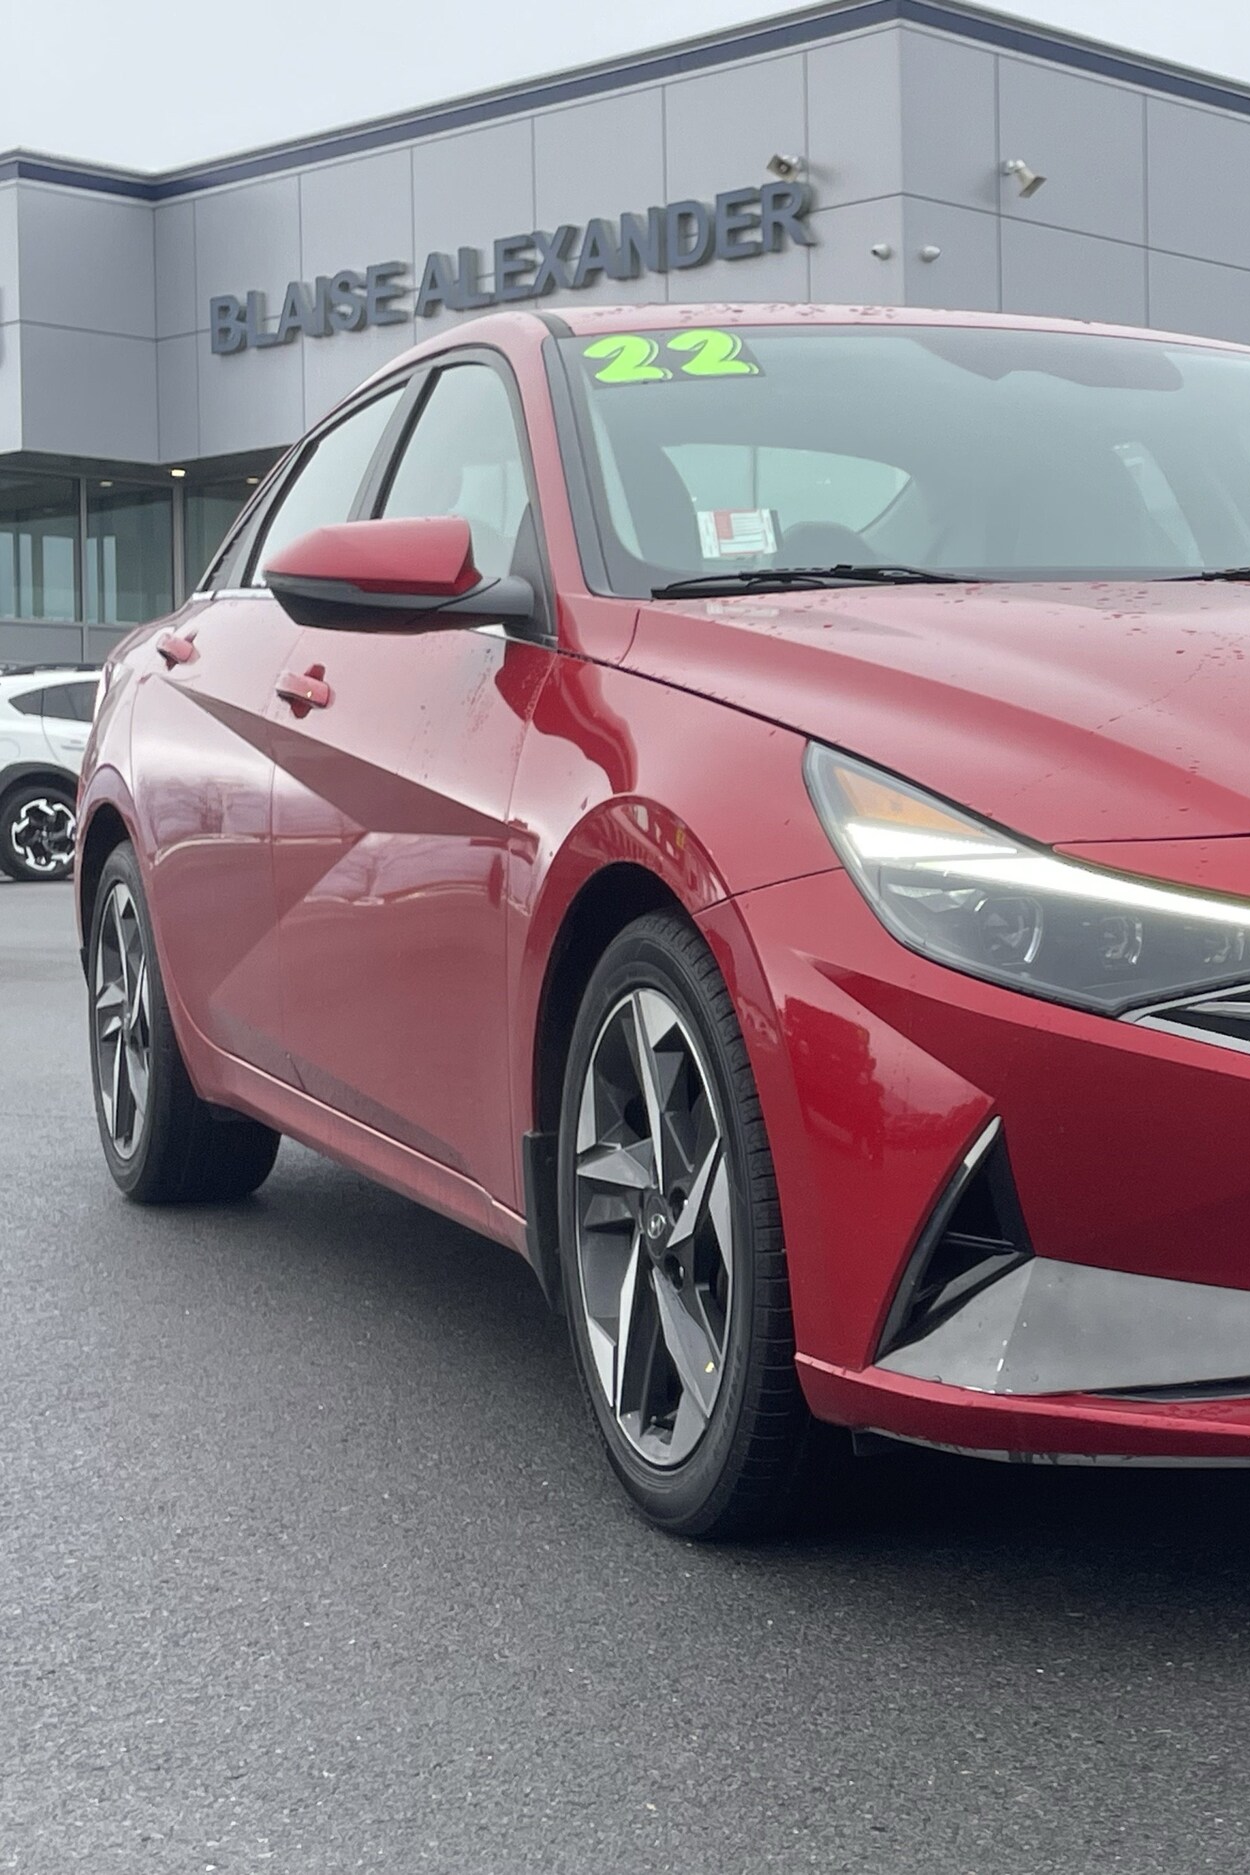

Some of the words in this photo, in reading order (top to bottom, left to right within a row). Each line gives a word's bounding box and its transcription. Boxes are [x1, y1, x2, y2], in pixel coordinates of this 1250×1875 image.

[209, 260, 411, 355] BLAISE
[414, 181, 817, 318] ALEXANDER
[582, 329, 760, 383] 22
